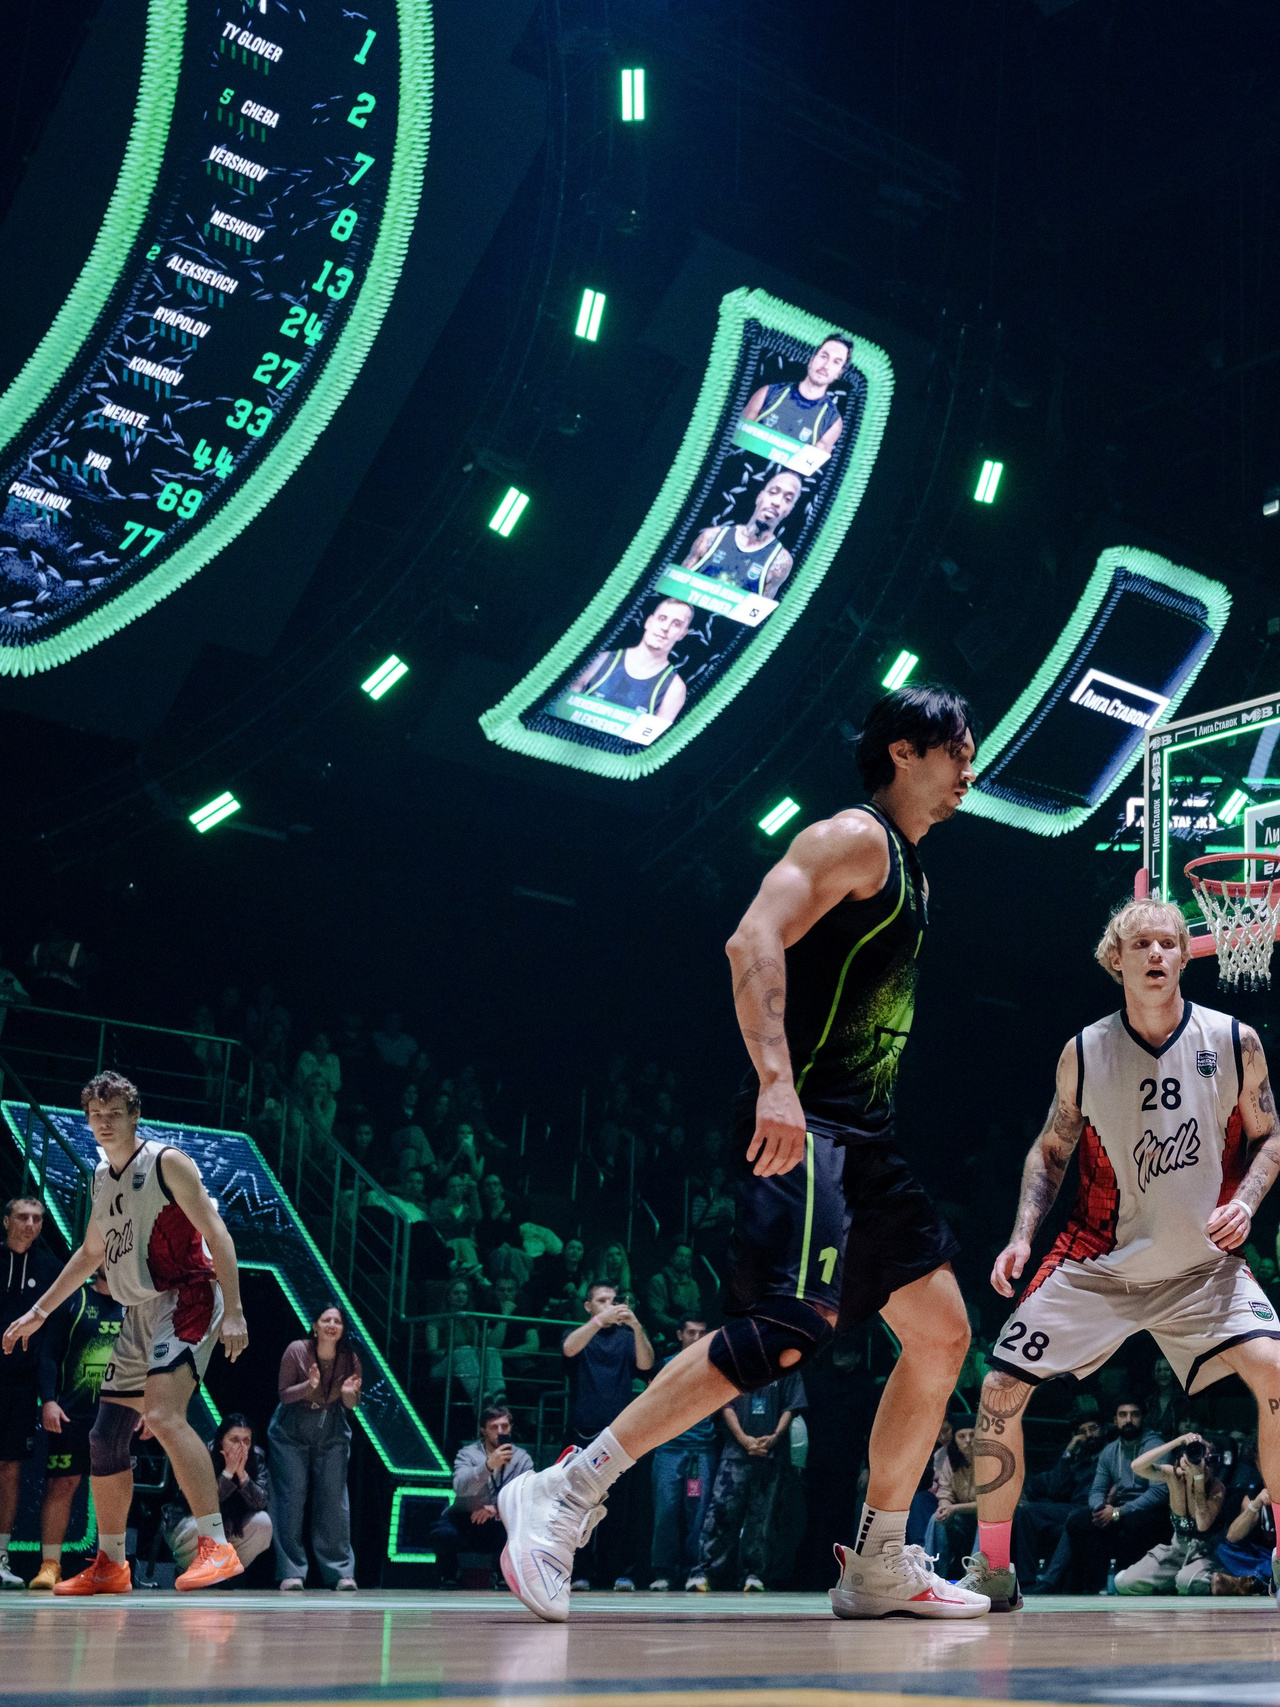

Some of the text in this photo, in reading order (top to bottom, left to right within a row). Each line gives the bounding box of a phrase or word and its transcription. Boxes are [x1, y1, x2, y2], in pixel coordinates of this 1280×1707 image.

[222, 22, 283, 63] TY GLOVER
[354, 30, 376, 65] 1
[241, 100, 280, 128] CHEBA
[347, 92, 376, 128] 2
[208, 146, 268, 182] VERSHKOV
[348, 152, 375, 186] 7
[209, 210, 265, 243] MESHKOV
[330, 209, 358, 242] 8
[146, 246, 239, 295] 2 ALEKSIEVICH
[311, 261, 354, 300] 13
[152, 306, 211, 338] RYAPOLOV
[279, 306, 323, 347] 24
[128, 356, 184, 387] KOMAROV
[252, 352, 301, 390] 27
[102, 402, 150, 430] MEHATE
[225, 398, 273, 438] 33
[85, 450, 112, 472] YMB
[192, 438, 234, 479] 44
[8, 481, 72, 513] PCHELINOV
[156, 481, 203, 520] 69
[118, 521, 165, 558] 77
[1139, 1078, 1182, 1111] 28
[818, 1245, 838, 1285] 1
[98, 1321, 122, 1334] 33
[999, 1321, 1050, 1362] 28
[47, 1454, 72, 1470] 33
